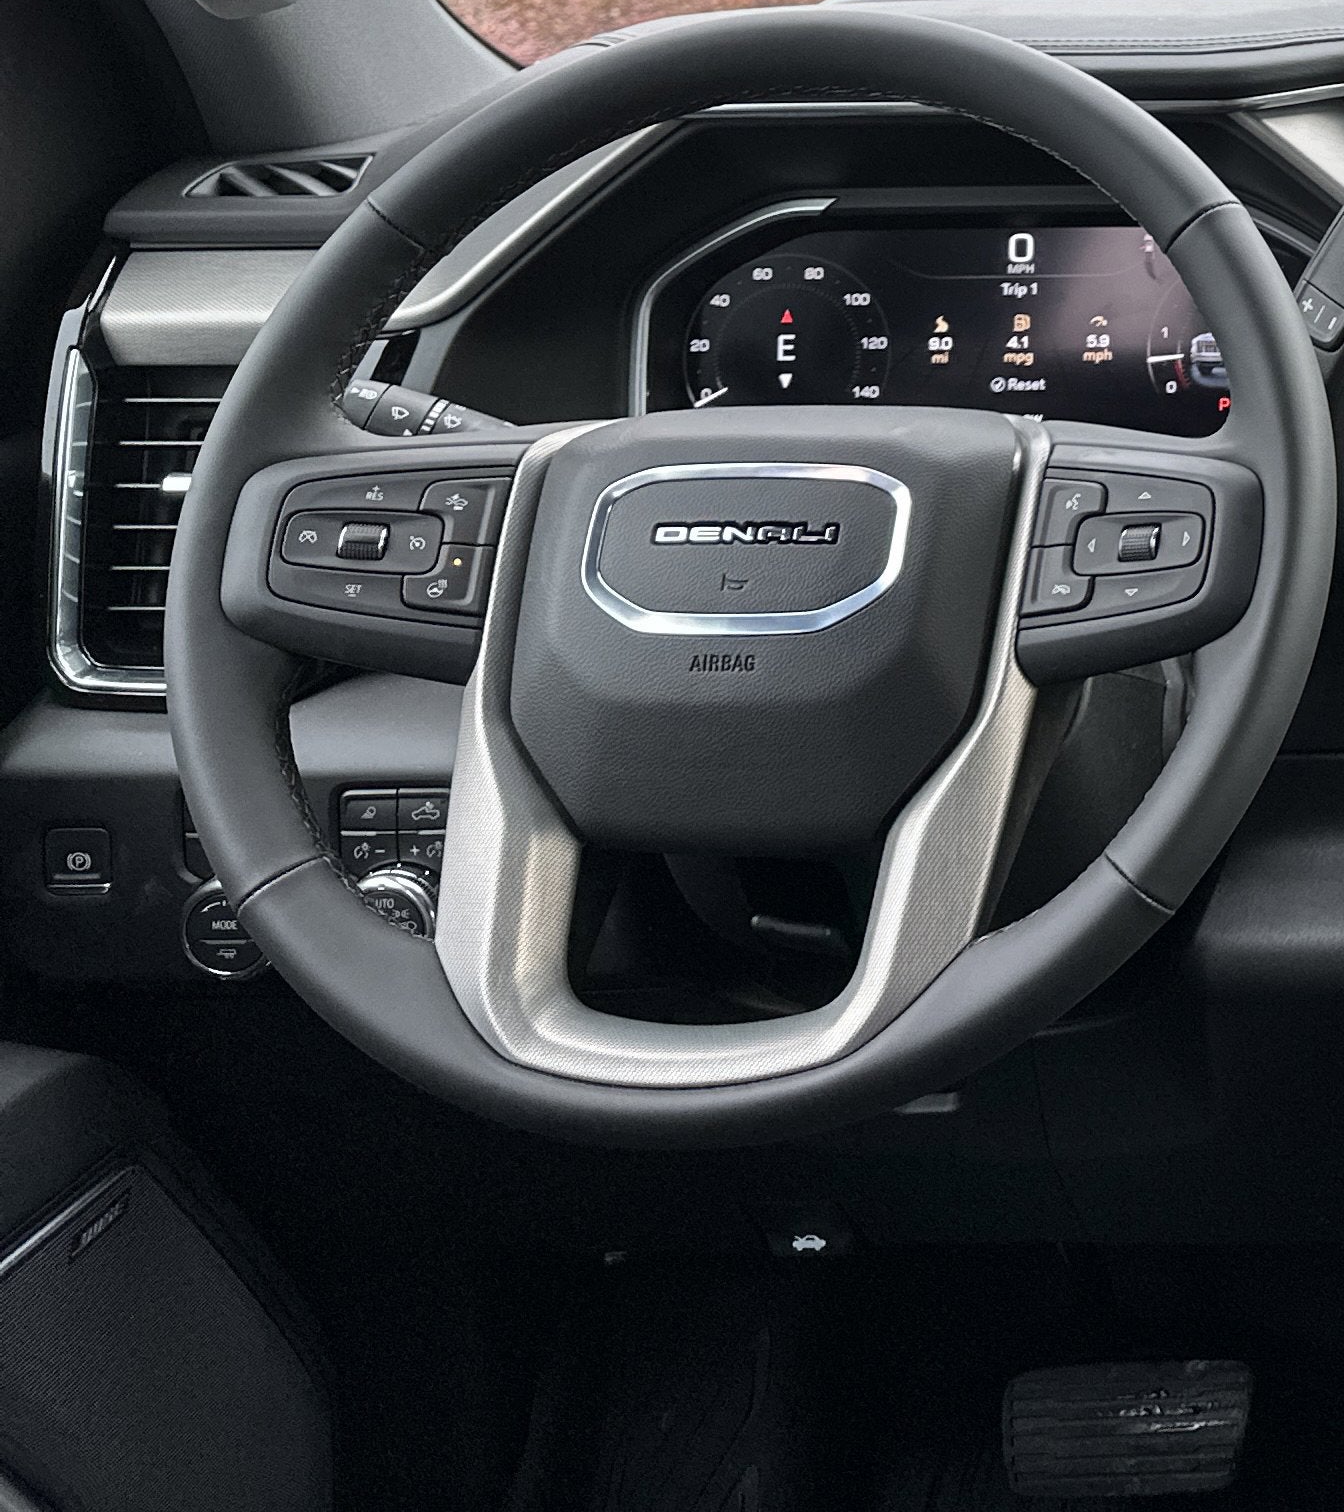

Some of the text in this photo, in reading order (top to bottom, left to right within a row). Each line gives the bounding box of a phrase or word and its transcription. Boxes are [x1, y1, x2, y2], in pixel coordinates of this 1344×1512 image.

[1008, 232, 1035, 263] 0
[804, 266, 825, 280] 80
[1007, 263, 1035, 274] MPH
[1000, 281, 1039, 298] Trip 1
[709, 293, 731, 307] 40
[843, 292, 871, 306] 100
[1160, 326, 1169, 338] 1
[690, 338, 711, 352] 20
[776, 333, 796, 361] E
[860, 336, 889, 350] 120
[1005, 335, 1029, 349] 4.1
[930, 352, 949, 364] mi
[1003, 352, 1035, 367] mpg
[1083, 348, 1113, 364] mph
[1007, 377, 1046, 391] Reset
[1165, 380, 1177, 393] 0
[851, 386, 880, 399] 140
[1218, 397, 1231, 411] P
[653, 524, 838, 544] DENALI
[344, 584, 362, 594] SET
[689, 653, 756, 672] AIRBAG
[372, 897, 396, 909] UTO
[211, 919, 238, 930] MODE
